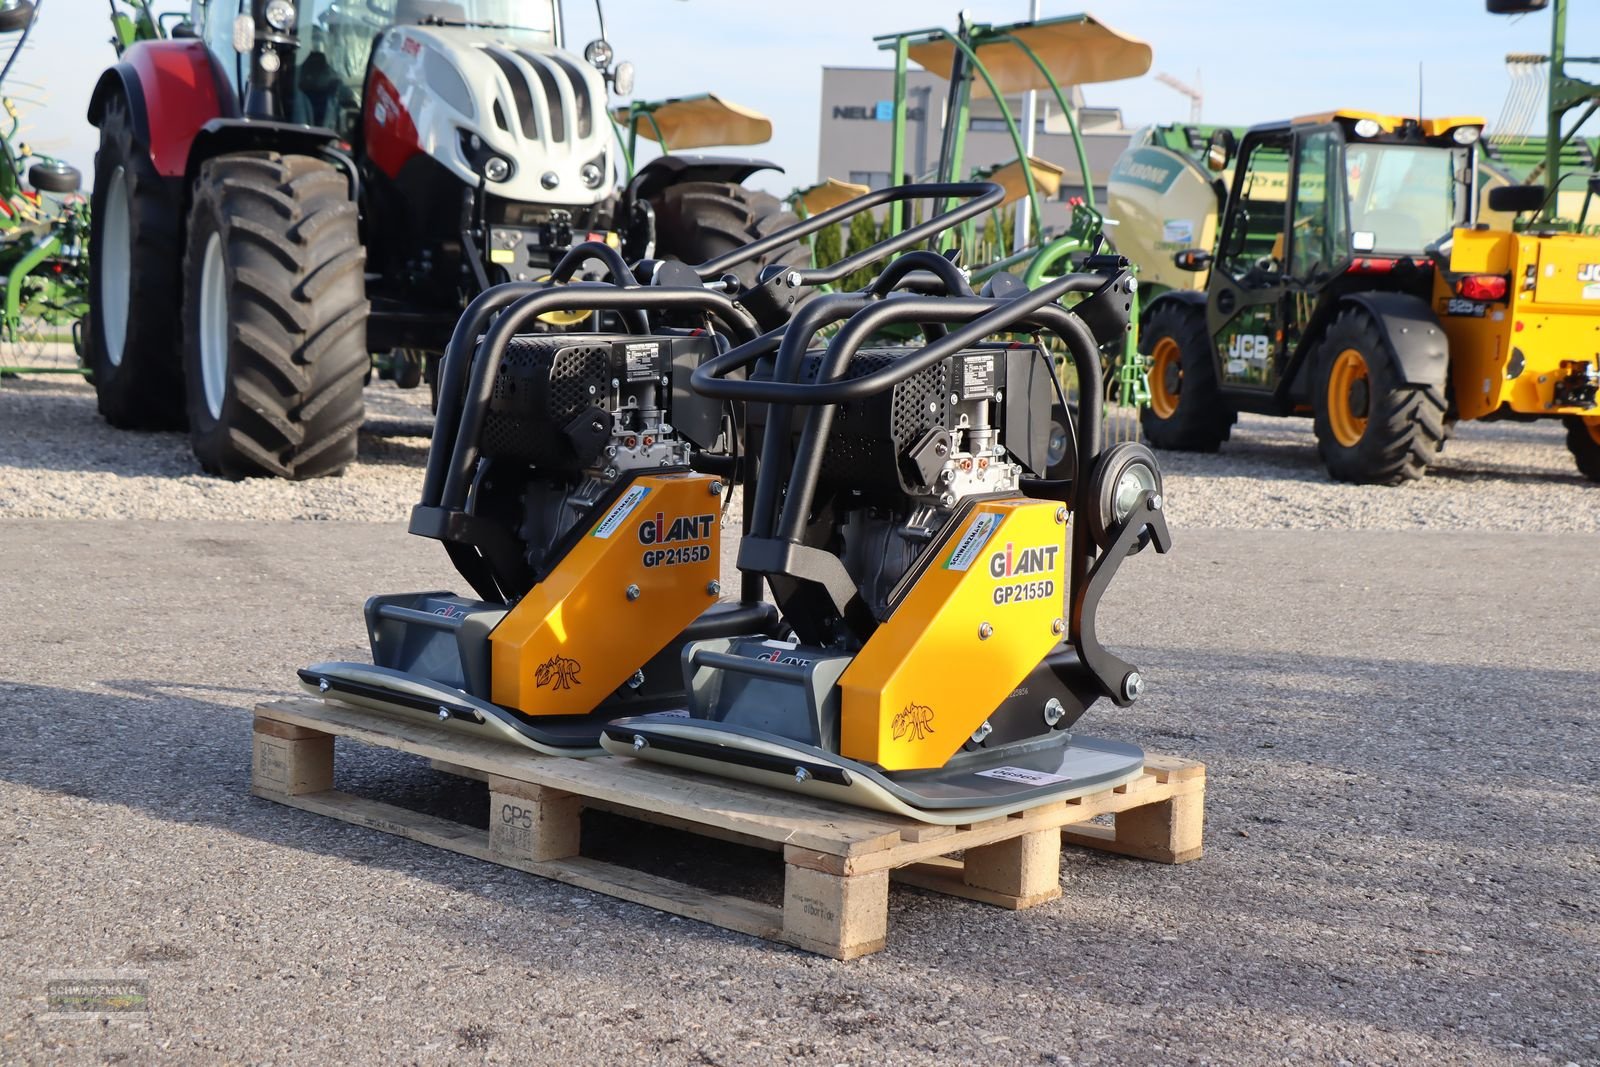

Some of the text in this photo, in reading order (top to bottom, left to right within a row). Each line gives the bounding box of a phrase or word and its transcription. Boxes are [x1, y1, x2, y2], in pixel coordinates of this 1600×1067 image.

[1228, 334, 1269, 358] JCB
[949, 520, 985, 566] SCHWARZMAYR
[643, 546, 710, 567] GP2155D
[993, 580, 1054, 605] GP2155D
[502, 804, 532, 829] CP5
